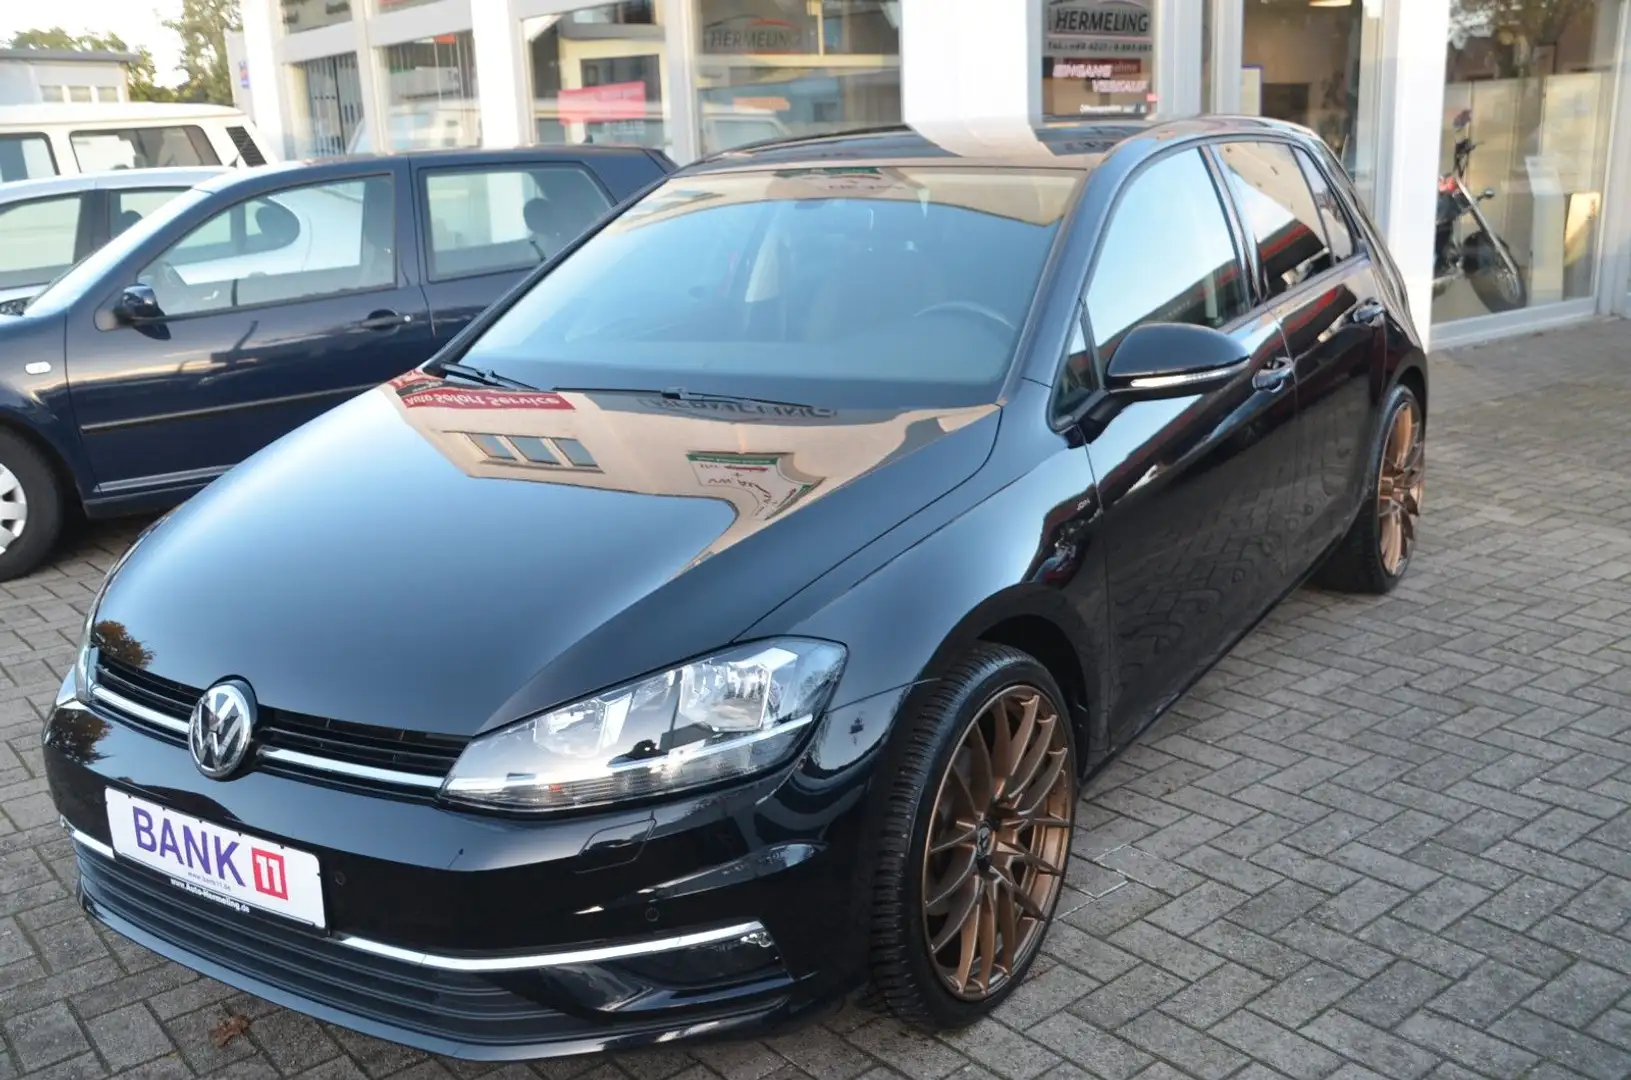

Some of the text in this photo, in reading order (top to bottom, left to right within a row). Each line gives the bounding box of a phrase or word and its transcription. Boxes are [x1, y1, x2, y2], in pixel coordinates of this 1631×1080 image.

[1055, 9, 1148, 32] HERMELING
[132, 806, 286, 897] BANK 11
